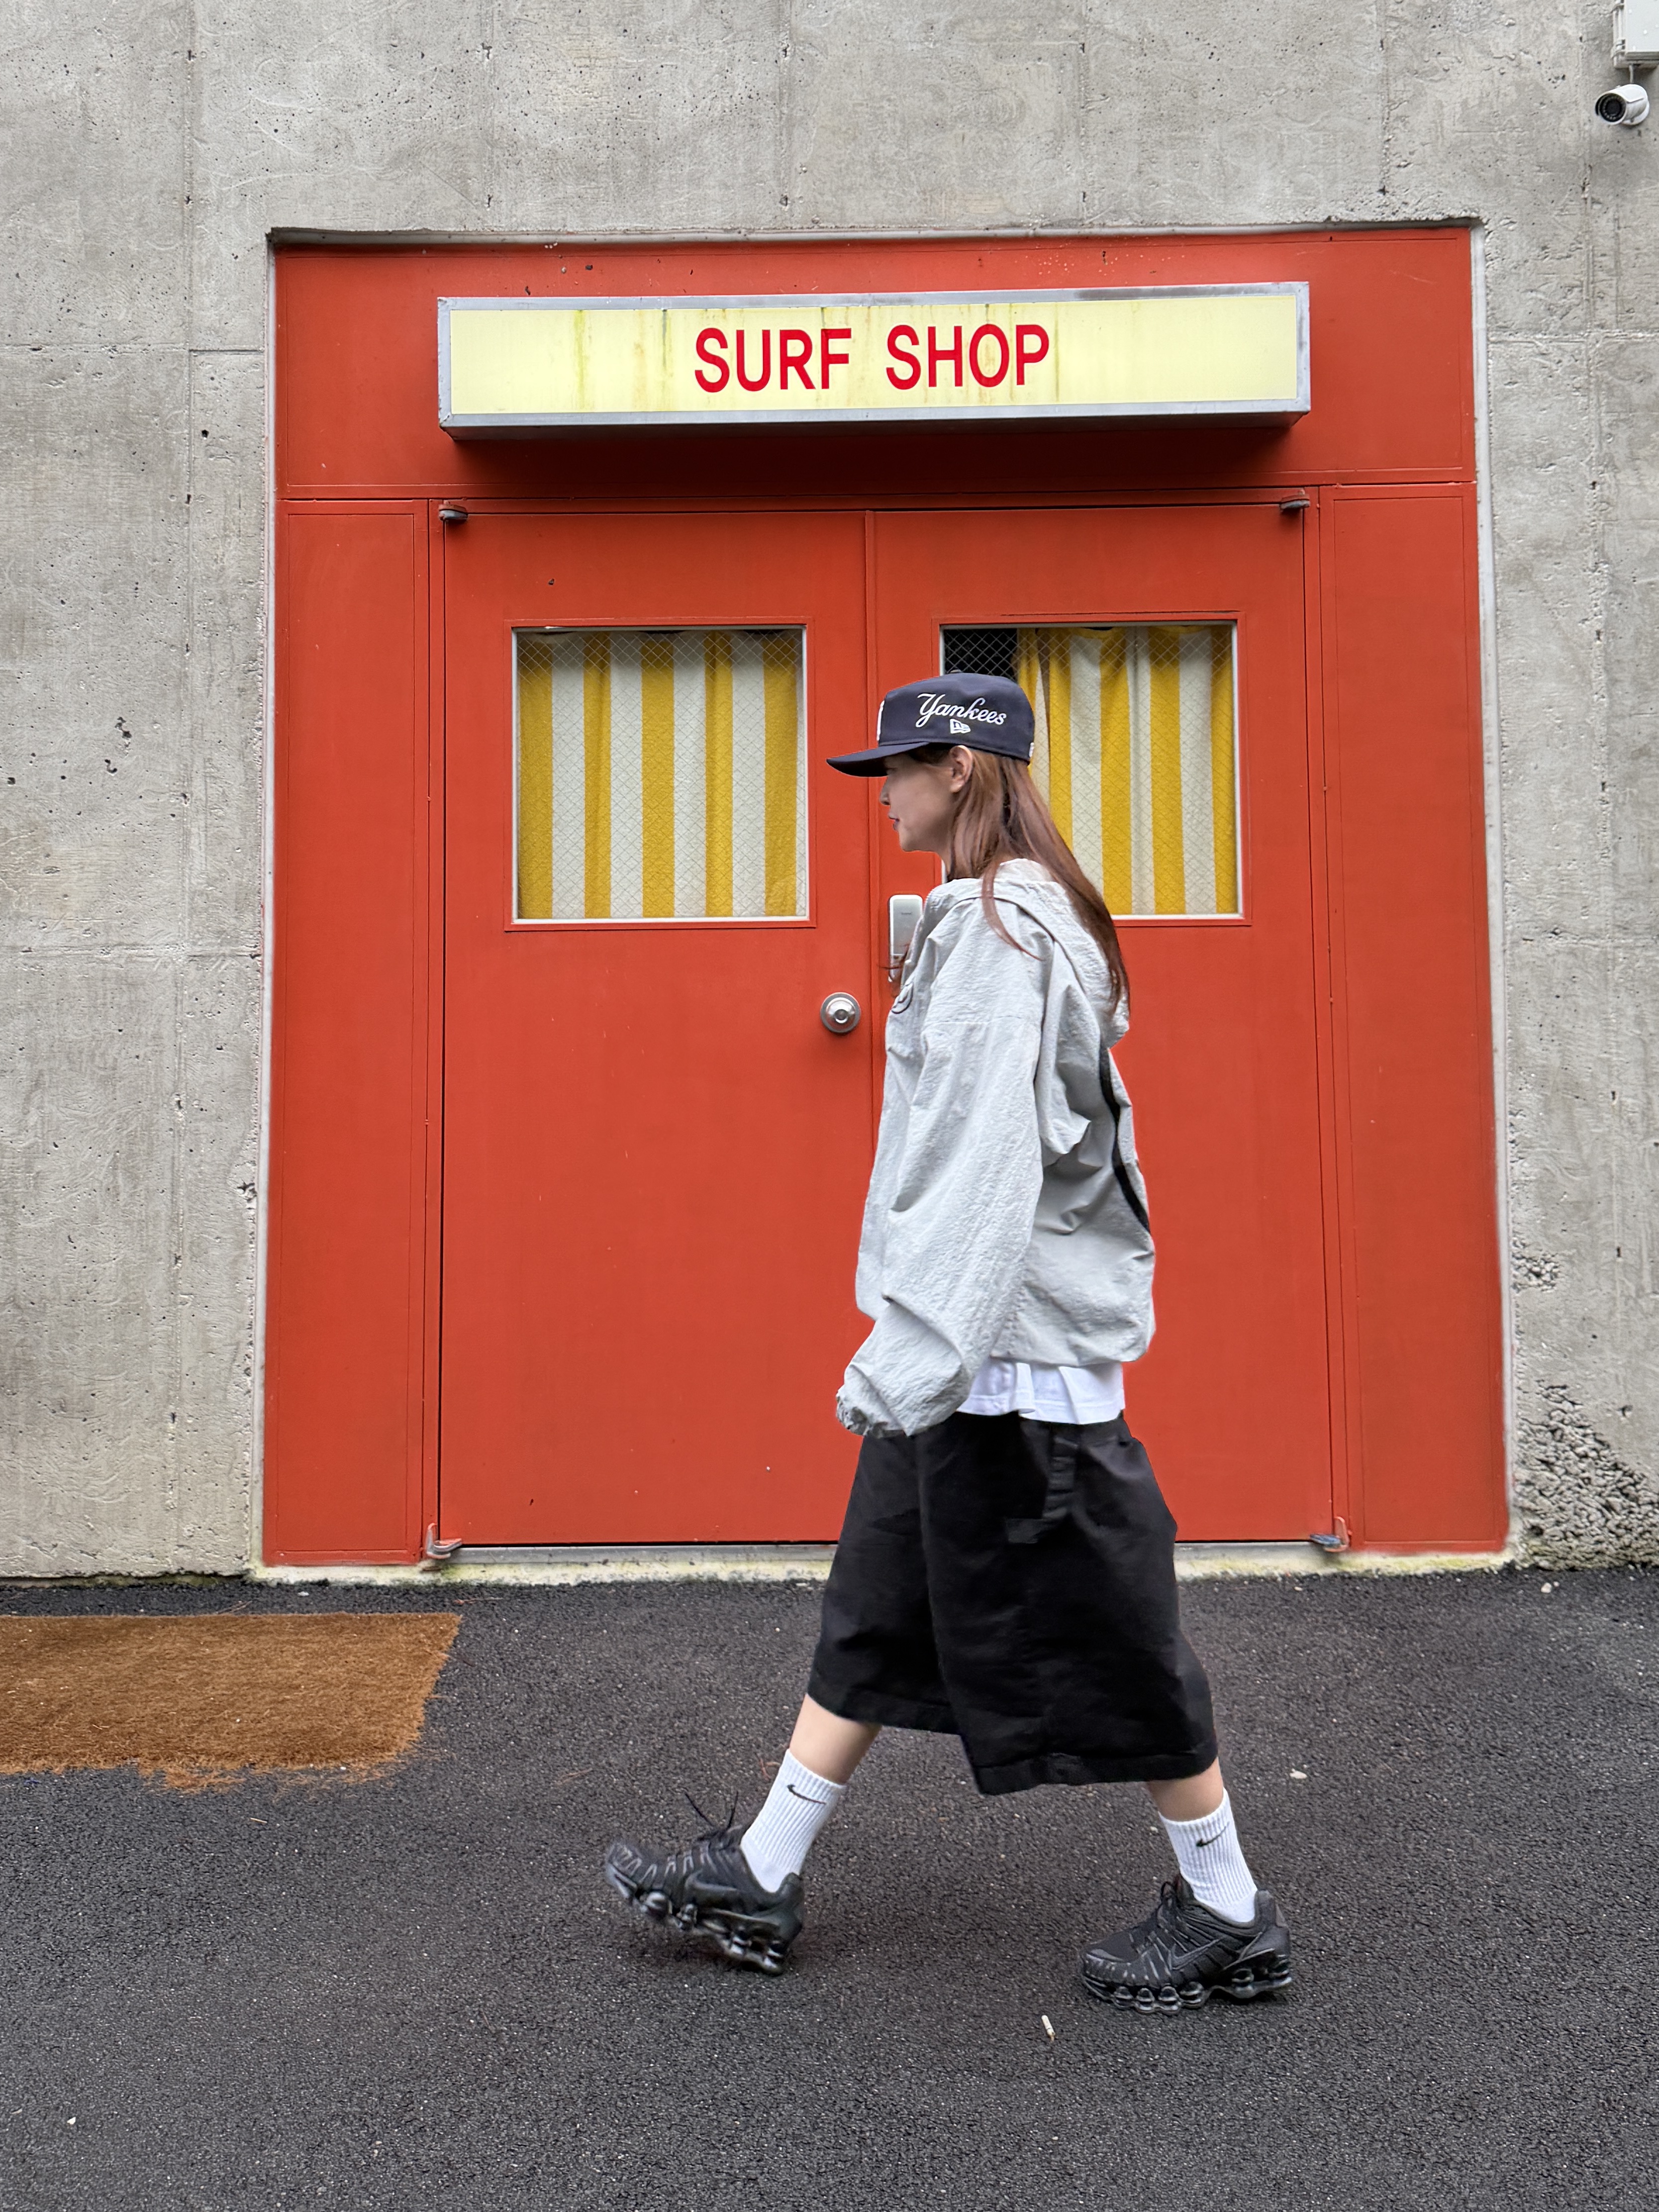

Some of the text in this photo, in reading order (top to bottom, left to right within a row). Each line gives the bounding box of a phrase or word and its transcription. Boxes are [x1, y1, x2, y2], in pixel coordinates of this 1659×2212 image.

[694, 324, 1050, 393] SURF SHOP
[915, 693, 1007, 728] Yankees
